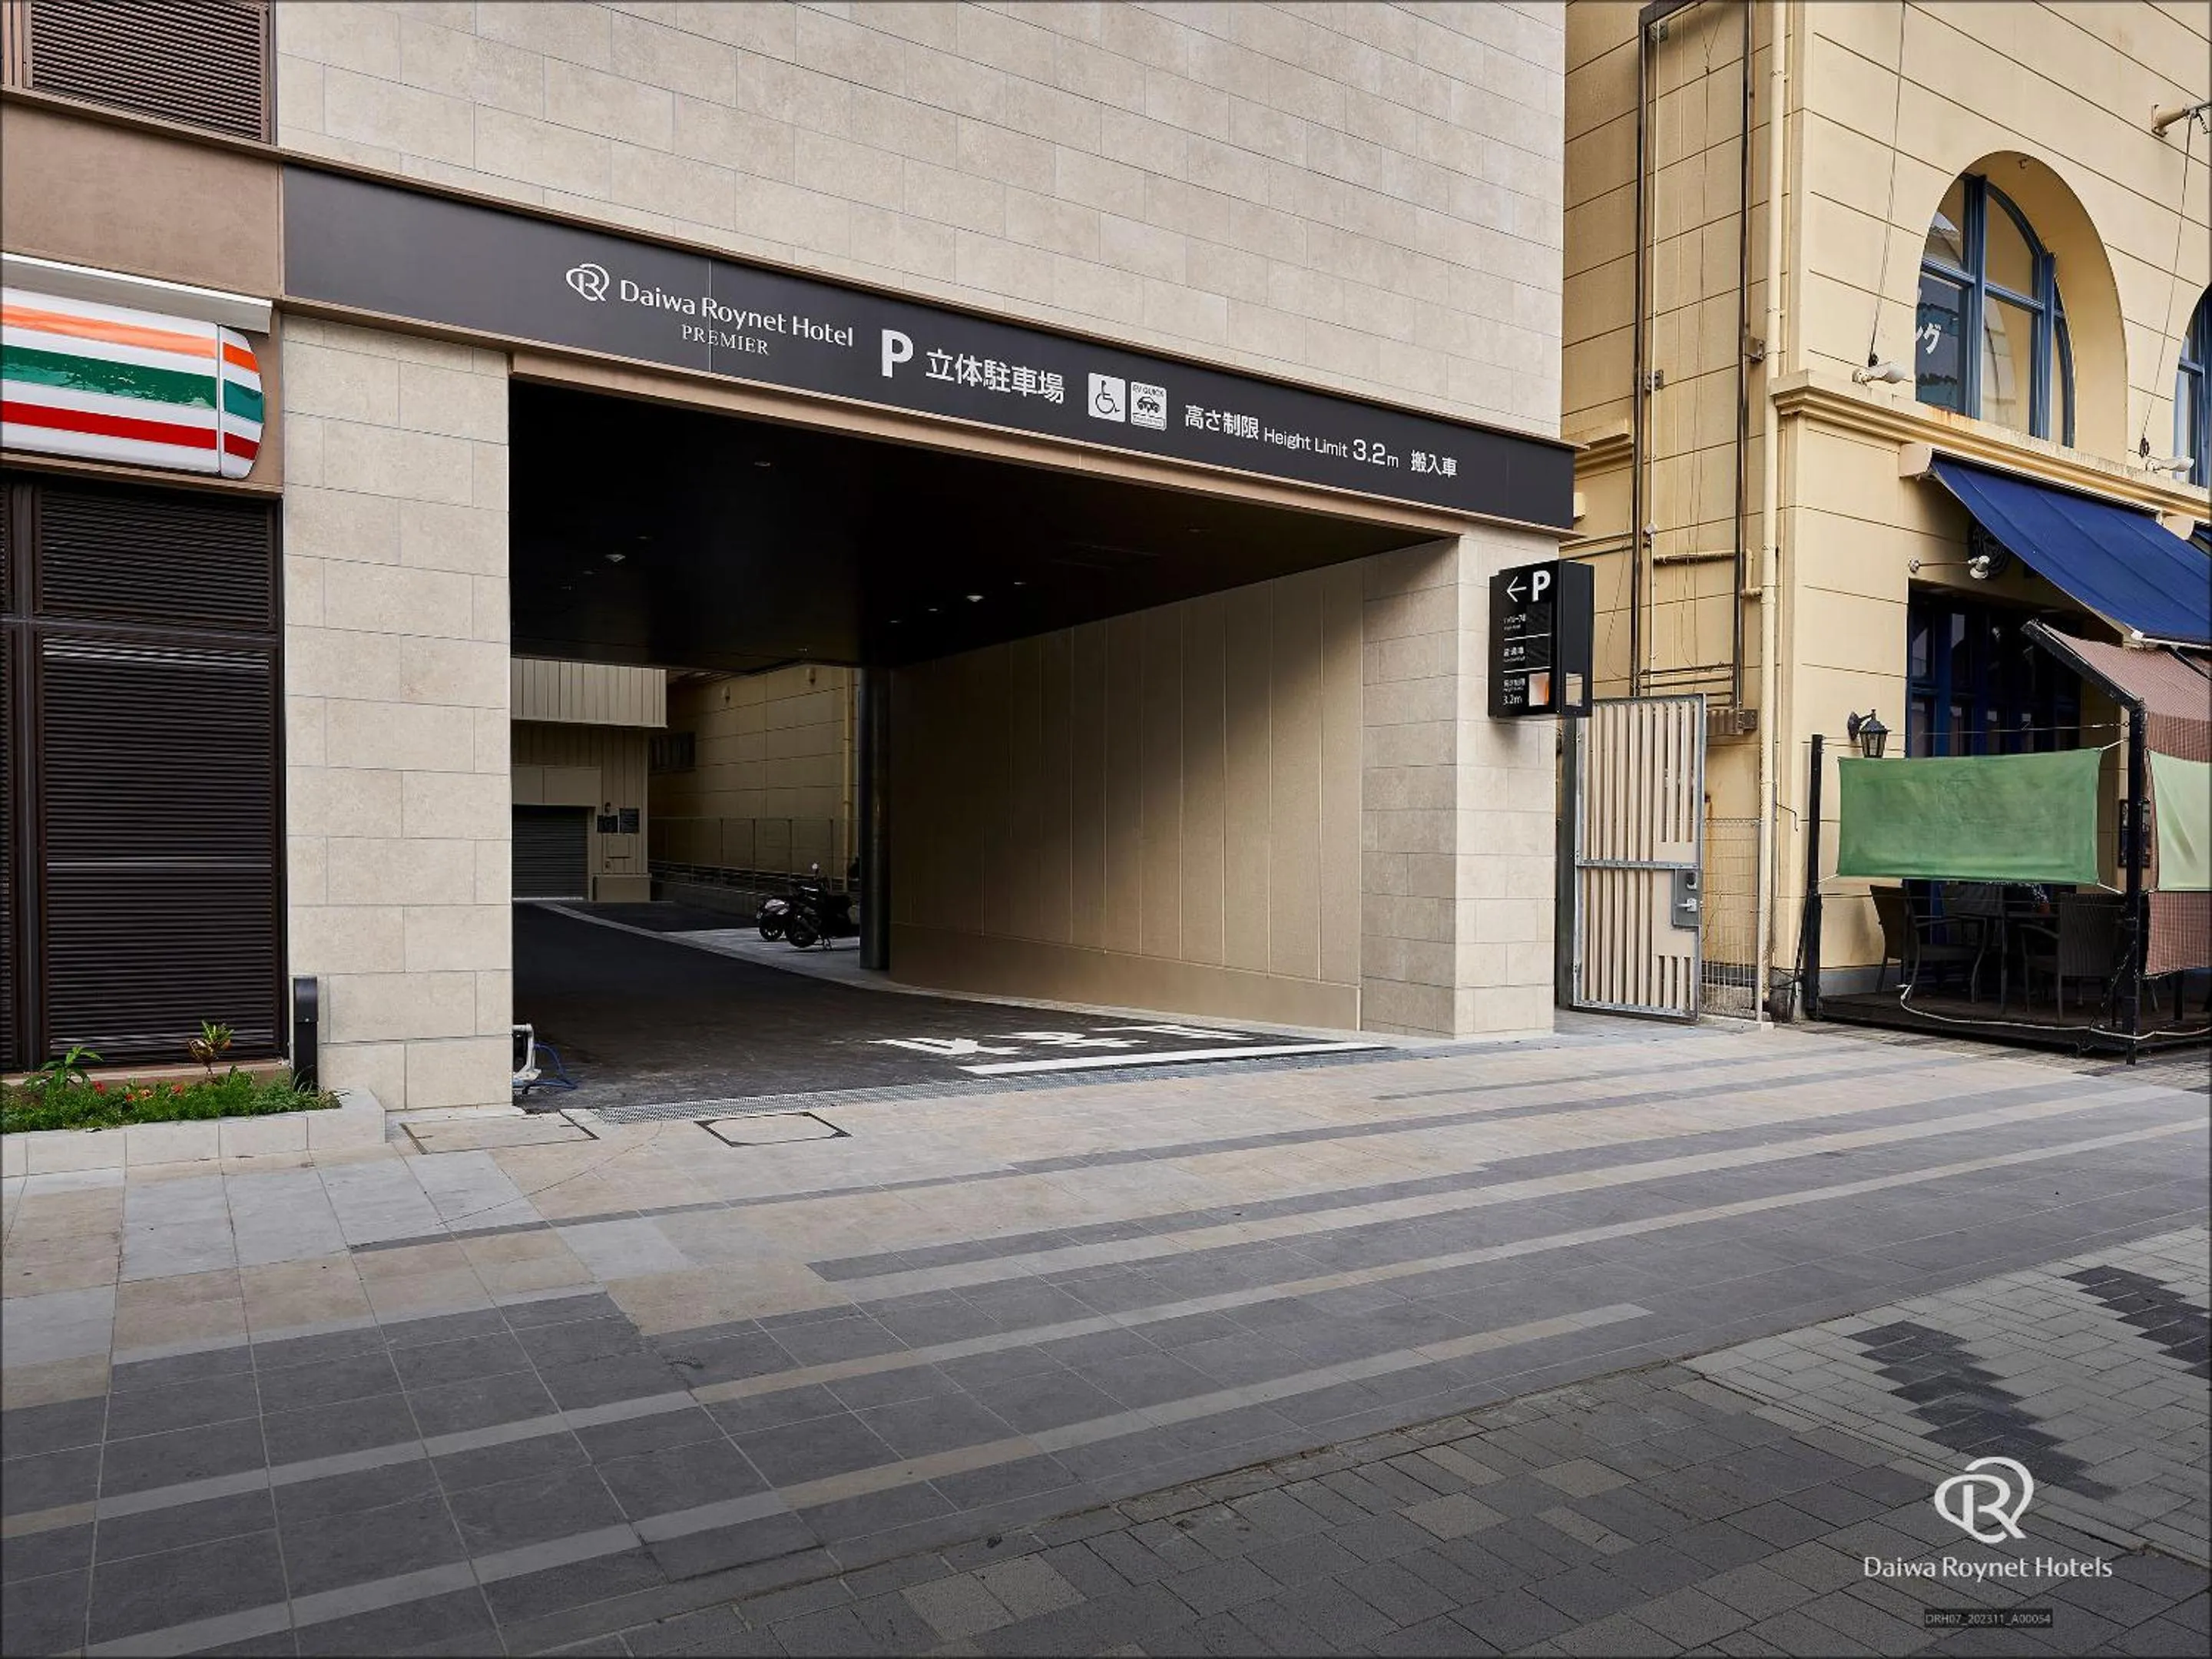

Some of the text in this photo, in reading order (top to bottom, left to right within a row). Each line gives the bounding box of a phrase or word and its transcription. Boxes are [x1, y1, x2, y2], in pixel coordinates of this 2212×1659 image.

[620, 280, 853, 347] Daiwa Roynet Hotel
[681, 324, 770, 356] PREMIER
[882, 329, 1065, 404] P 立体駐車場
[1185, 405, 1259, 440] 高さ制限
[1264, 427, 1311, 451] Height
[1315, 437, 1348, 459] Limit
[1411, 449, 1457, 478] 搬入車
[1532, 570, 1551, 602] P
